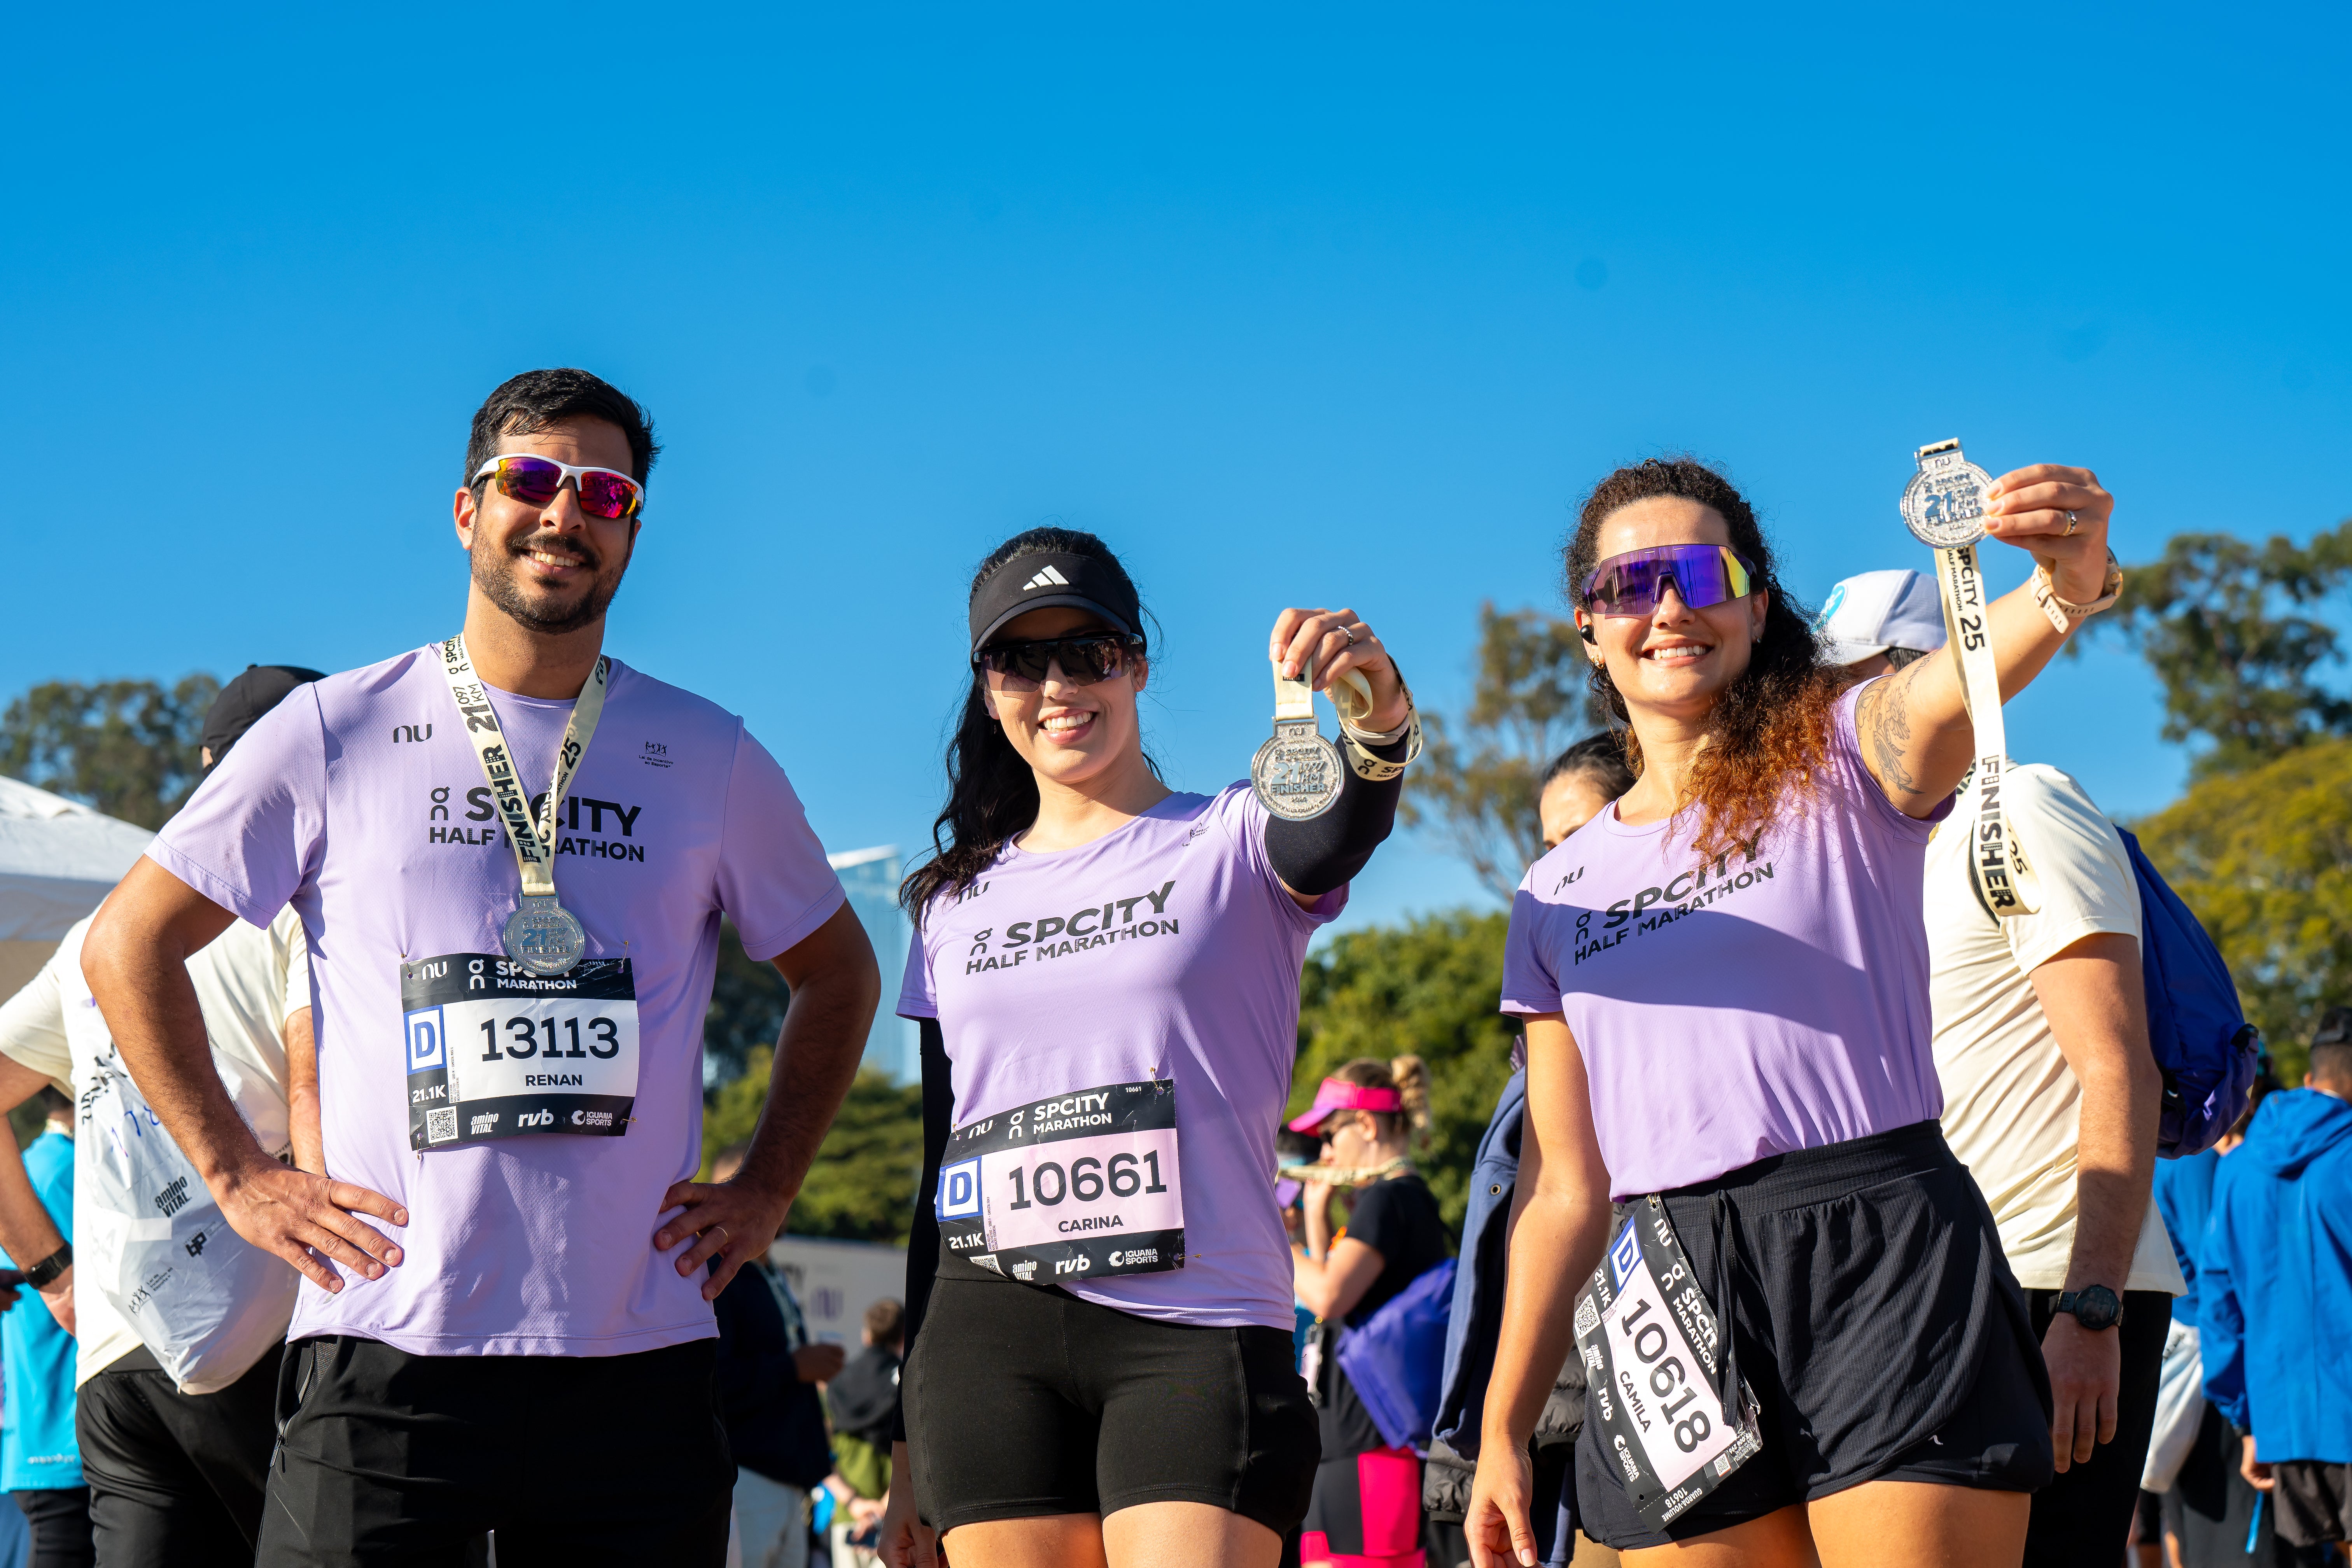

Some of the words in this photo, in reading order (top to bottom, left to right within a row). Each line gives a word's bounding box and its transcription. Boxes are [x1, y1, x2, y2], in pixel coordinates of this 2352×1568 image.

[1925, 491, 1952, 518] 21
[1951, 567, 1963, 611] MARATHON
[1960, 614, 1985, 651] 25
[467, 684, 485, 702] KM
[461, 704, 499, 733] 21
[393, 723, 432, 743] nu
[559, 736, 581, 770] 25
[1271, 762, 1302, 784] 21
[1301, 772, 1321, 782] KM
[1270, 784, 1325, 794] FINISHER
[483, 744, 541, 863] FINISHER
[430, 827, 496, 845] HALF
[1980, 754, 2016, 910] FINISHER
[1002, 880, 1176, 948] SPCITY
[1575, 927, 1630, 966] HALF
[1637, 862, 1774, 936] MARATHON
[522, 929, 547, 947] 21
[966, 950, 1028, 975] HALF
[1036, 919, 1180, 962] MARATHON
[522, 946, 571, 955] FINISHER
[422, 961, 447, 980] nu
[497, 978, 576, 989] MARATHON
[414, 1021, 436, 1059] D
[481, 1016, 620, 1062] 13113
[525, 1074, 583, 1086] RENAN
[412, 1084, 446, 1103] 21.1K
[471, 1112, 499, 1125] amino
[518, 1109, 554, 1127] rvb
[586, 1118, 611, 1126] SPORTS
[587, 1111, 612, 1120] IGUANA
[968, 1120, 993, 1139] nu
[1033, 1092, 1109, 1121] SPCITY
[1033, 1112, 1112, 1135] MARATHON
[471, 1124, 493, 1135] VITAL
[949, 1172, 971, 1206] D
[1009, 1149, 1167, 1210] 10661
[155, 1176, 188, 1209] amino
[1058, 1215, 1124, 1233] CARINA
[948, 1232, 985, 1250] 21.1K
[1055, 1254, 1090, 1275] rvb
[1125, 1248, 1158, 1258] IGUANA
[1125, 1256, 1158, 1265] SPORTS
[1618, 1237, 1633, 1273] D
[1012, 1260, 1037, 1273] amino
[1594, 1268, 1612, 1309] 21.1K
[1680, 1287, 1717, 1349] SPCIT
[1673, 1297, 1717, 1375] MARATHON
[1591, 1344, 1604, 1370] amino
[1621, 1298, 1711, 1454] 10618
[1598, 1387, 1613, 1421] rvb
[1620, 1371, 1651, 1433] CAMILA
[1619, 1450, 1635, 1482] SPORTS
[1623, 1447, 1640, 1480] IGUANA
[1664, 1487, 1688, 1508] 10618
